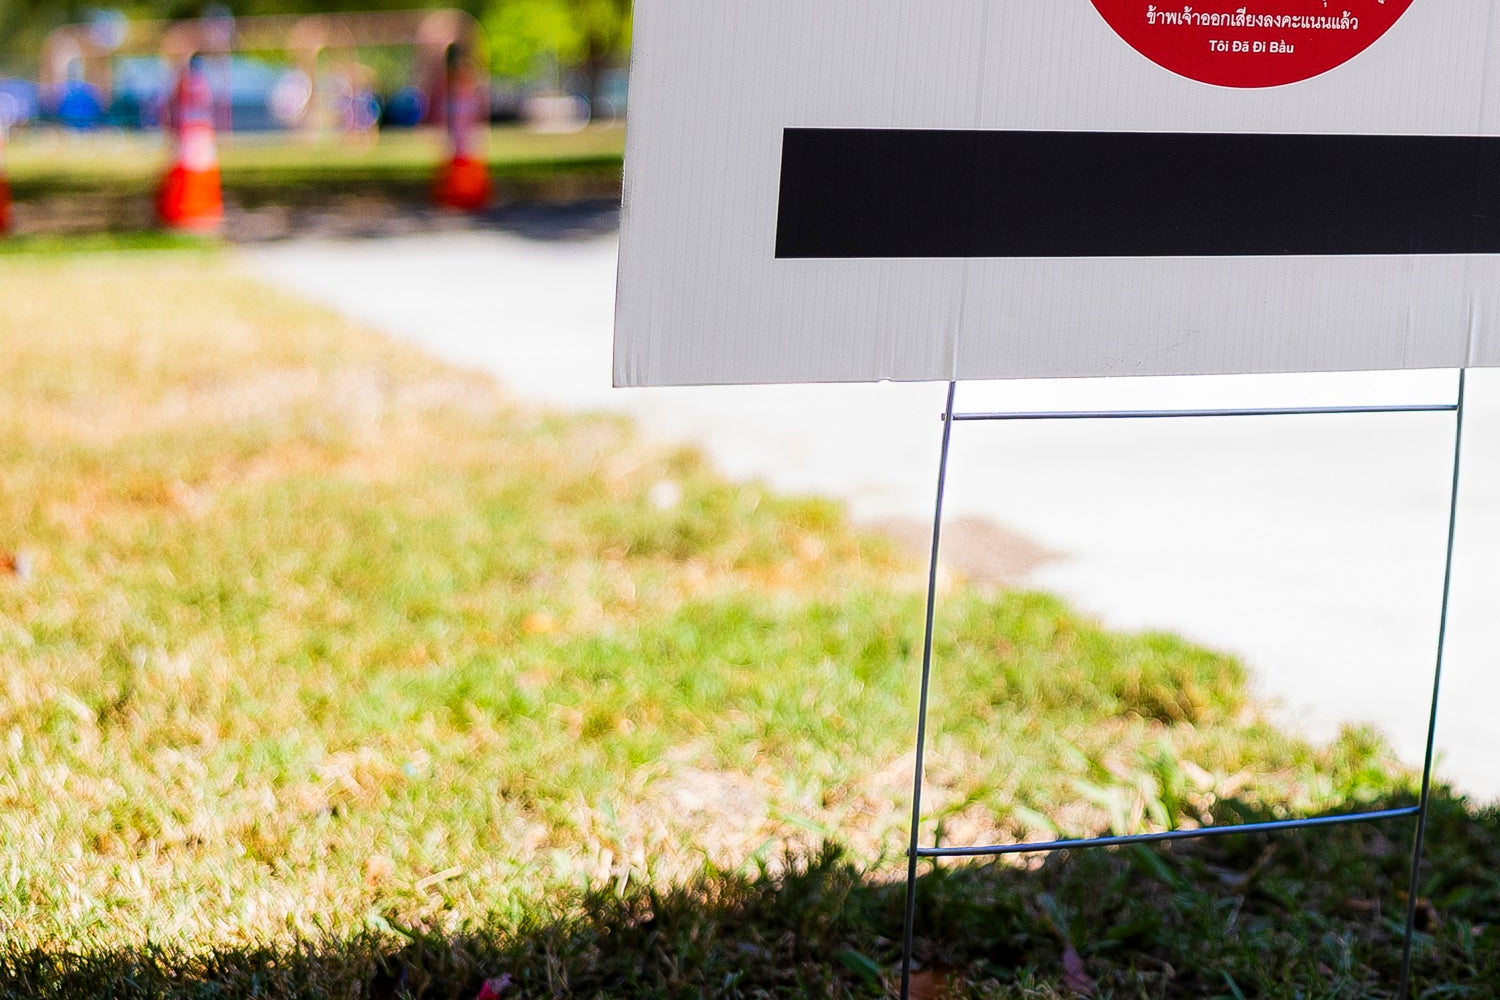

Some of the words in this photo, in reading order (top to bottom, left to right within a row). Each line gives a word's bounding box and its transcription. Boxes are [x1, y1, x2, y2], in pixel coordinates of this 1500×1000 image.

[1146, 4, 1359, 31] ข้าพเจ้าออกเสียงลงคะแนนแล้ว
[1208, 39, 1229, 52] Tôi
[1231, 40, 1250, 53] Đã
[1252, 41, 1267, 53] Đi
[1269, 38, 1295, 54] Bầu
